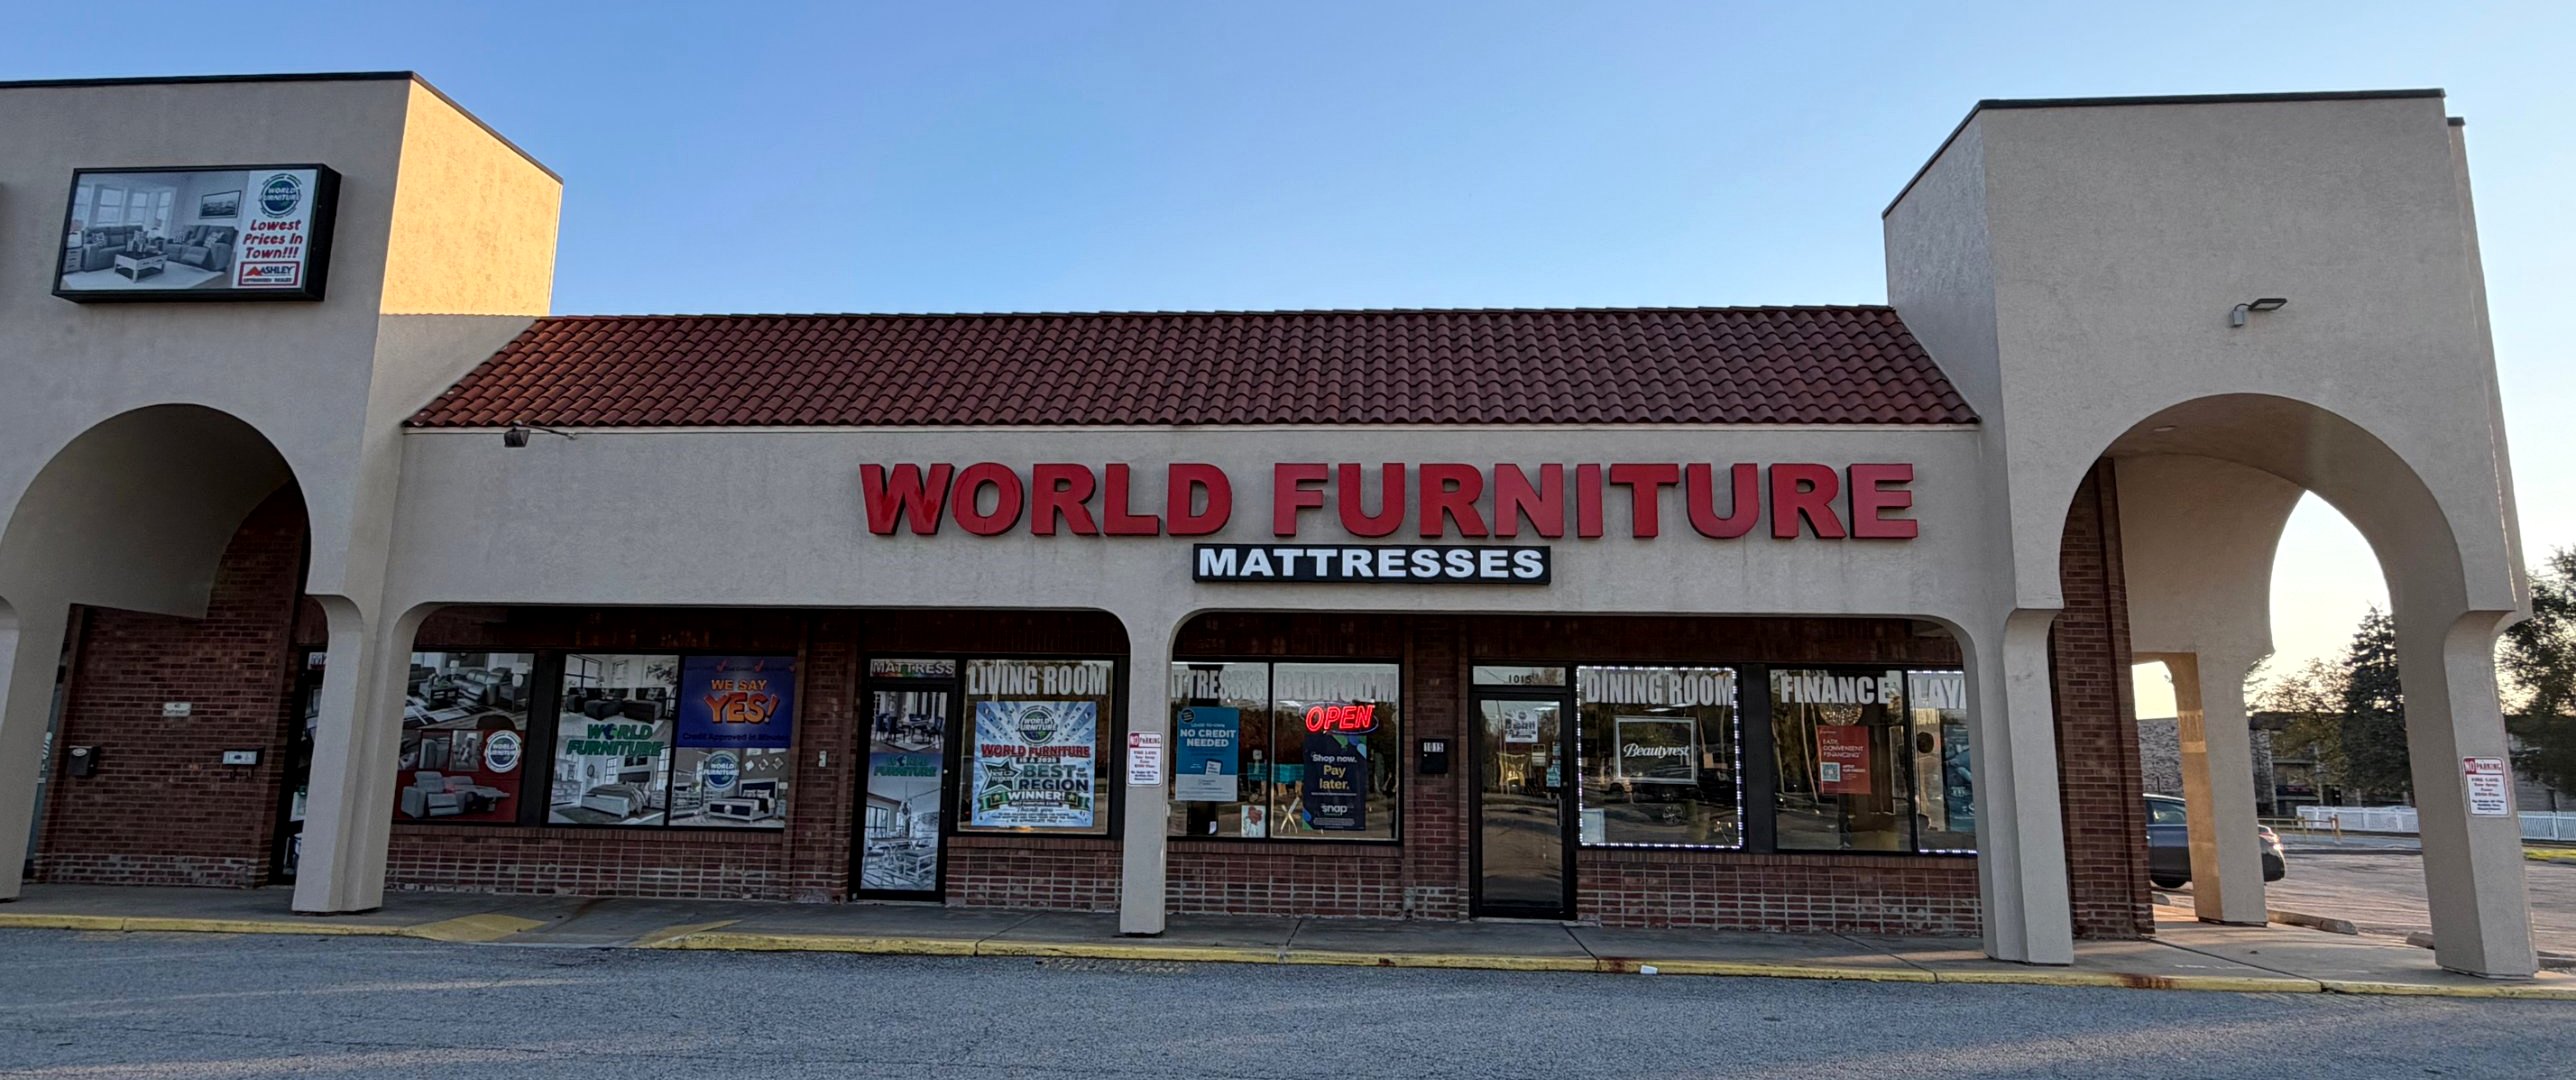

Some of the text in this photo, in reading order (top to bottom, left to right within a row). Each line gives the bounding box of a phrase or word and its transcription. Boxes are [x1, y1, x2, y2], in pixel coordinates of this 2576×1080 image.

[250, 219, 302, 231] Lowest
[243, 233, 303, 245] Prices In
[245, 247, 300, 259] Town!!!
[260, 266, 293, 275] ASHLEY
[859, 463, 1918, 540] WORLD FURNITURE
[1199, 548, 1544, 579] MATTRESSES
[872, 662, 954, 674] MATTRESS
[711, 679, 767, 690] WE SAY
[968, 665, 1107, 696] LIVING ROOM
[1508, 674, 1531, 683] 1015
[1278, 671, 1397, 702] BEDROOM
[1586, 674, 1734, 706] DINING ROOM
[1780, 676, 1893, 704] FINANCE
[703, 692, 780, 724] YES!
[1305, 704, 1374, 732] OPEN
[587, 723, 653, 740] WORLD
[1180, 729, 1237, 738] NO CREDIT
[1129, 735, 1139, 745] NO
[1186, 739, 1229, 748] NEEDED
[565, 739, 665, 756] FURNITURE
[981, 744, 1091, 758] WORLD FURNITURE
[1423, 742, 1444, 753] 1015
[1623, 743, 1690, 759] Beautyrest
[1312, 754, 1358, 763] Shop now.
[1023, 765, 1076, 778] BEST
[1323, 764, 1346, 778] Pay
[2464, 760, 2502, 772] NO PARKING
[1018, 779, 1089, 791] REGION
[1319, 778, 1350, 790] later.
[1007, 791, 1066, 801] WINNER!
[1321, 805, 1348, 814] snap
